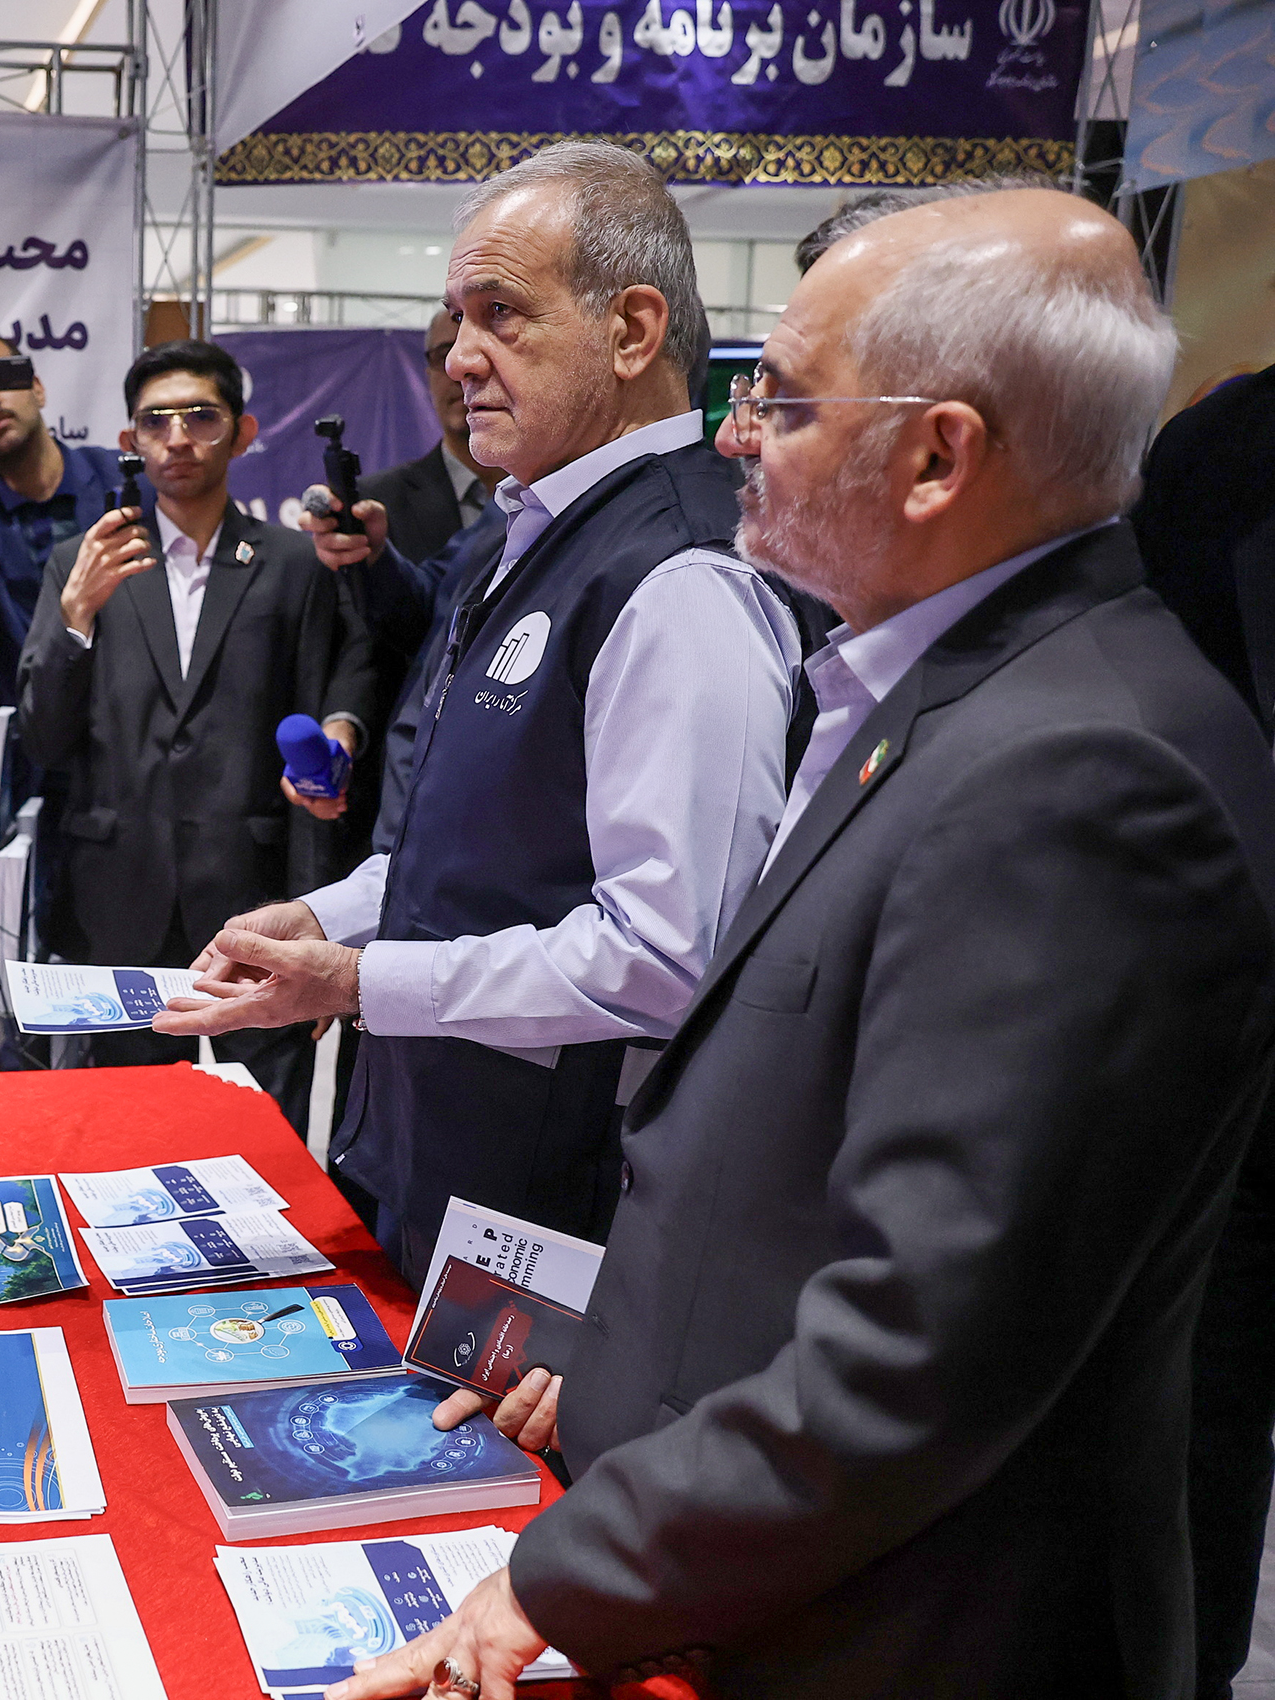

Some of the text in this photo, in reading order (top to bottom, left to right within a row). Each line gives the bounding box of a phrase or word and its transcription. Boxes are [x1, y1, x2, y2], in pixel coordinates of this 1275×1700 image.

[423, 0, 973, 86] سازمان برنامه و بودجه
[11, 314, 88, 351] مدی
[476, 1227, 498, 1267] E P
[493, 1232, 514, 1279] rated
[507, 1237, 528, 1284] conomic
[521, 1242, 544, 1288] mming
[500, 1313, 515, 1333] رصدخانه
[493, 1331, 507, 1350] اقتصادی
[484, 1350, 498, 1370] اجتماعی
[479, 1368, 491, 1381] ایران
[205, 1432, 229, 1451] پرداخت
[220, 1430, 243, 1448] نهایی
[216, 1450, 238, 1469] مستقیم
[227, 1468, 246, 1482] دولت
